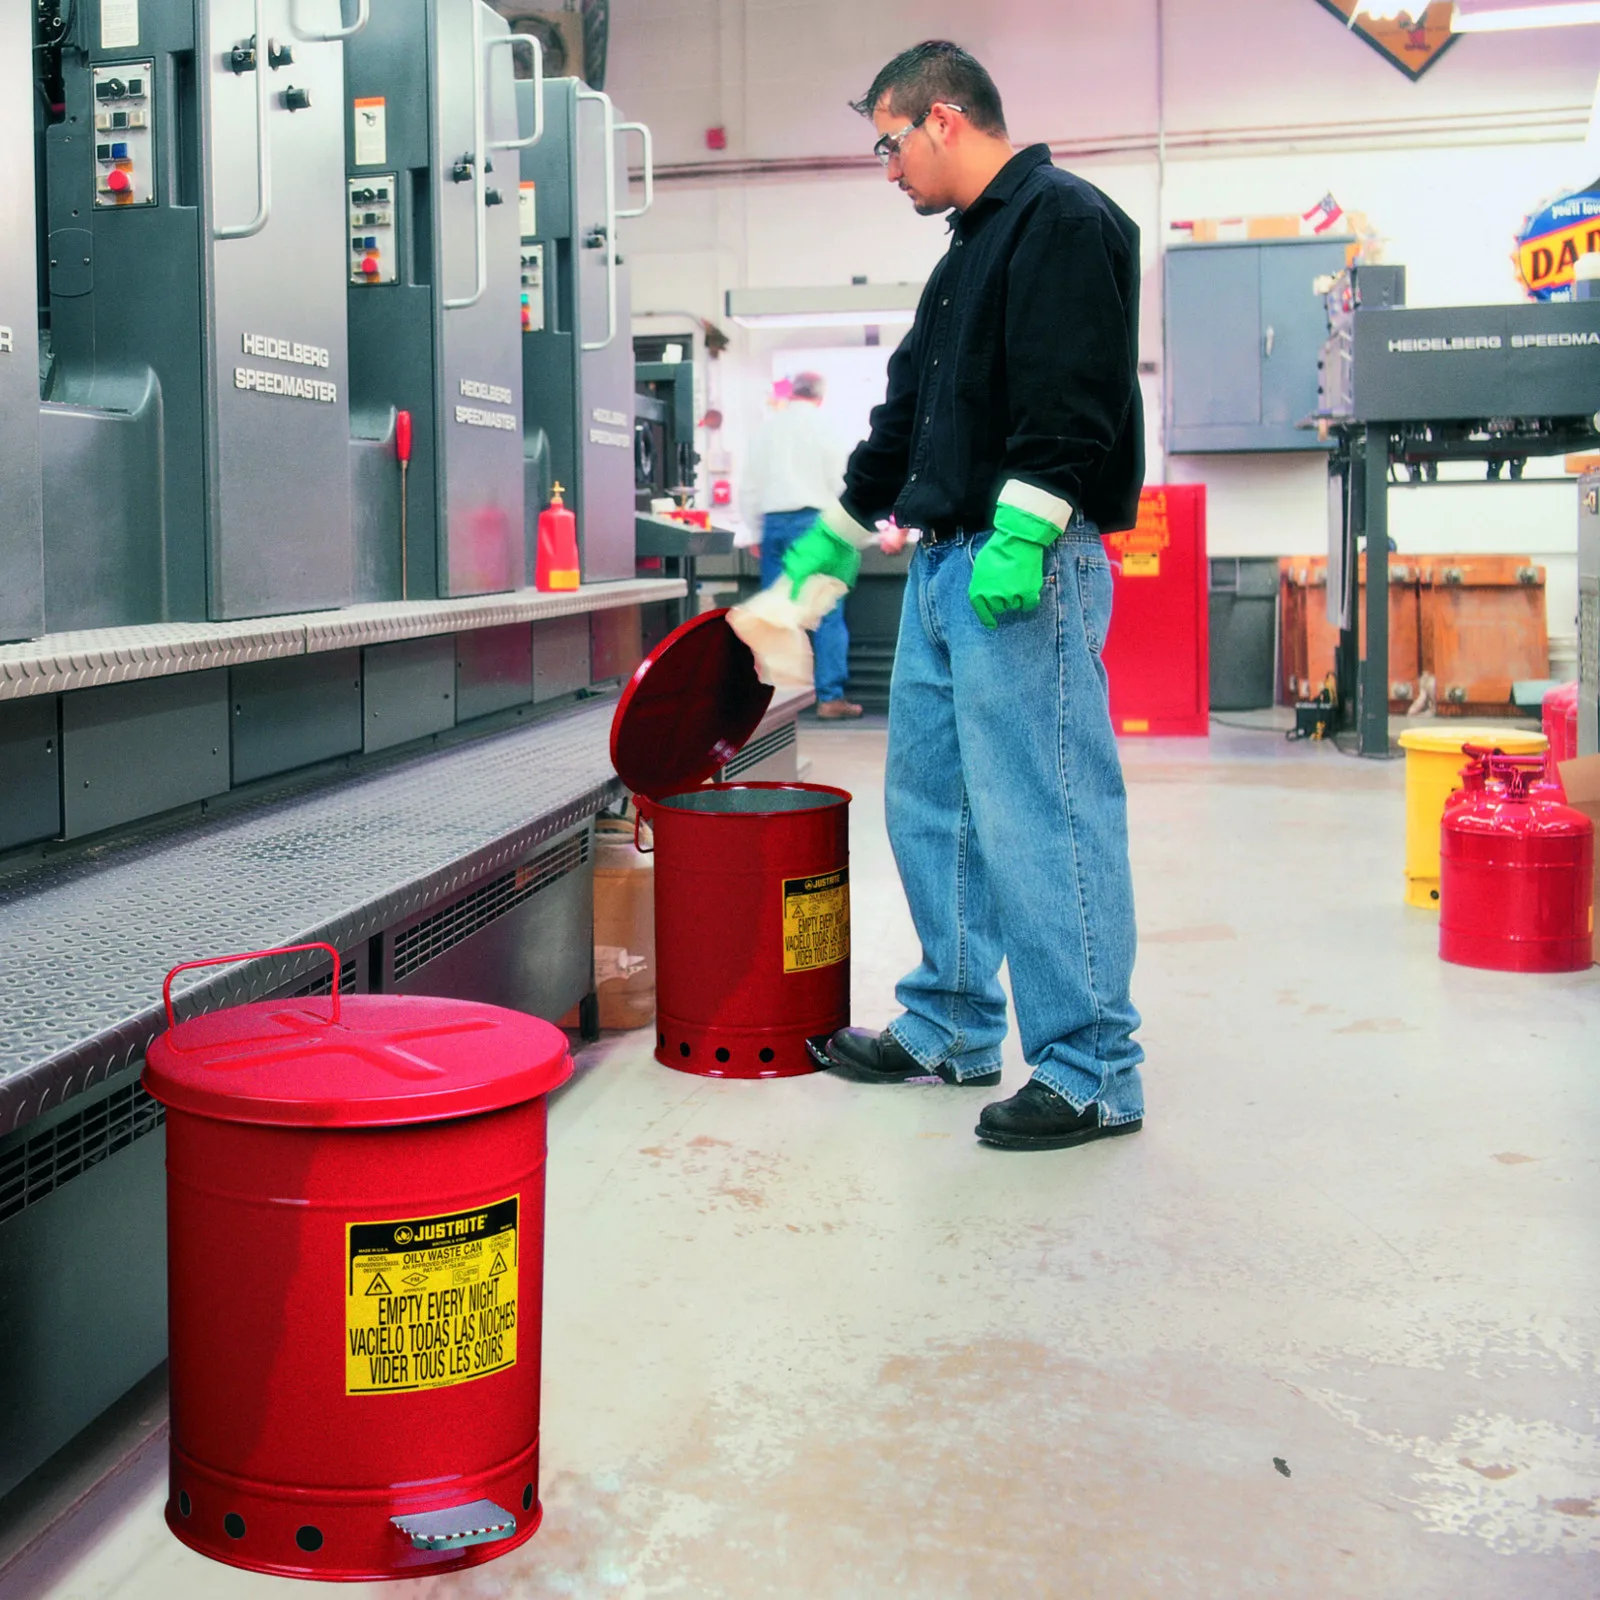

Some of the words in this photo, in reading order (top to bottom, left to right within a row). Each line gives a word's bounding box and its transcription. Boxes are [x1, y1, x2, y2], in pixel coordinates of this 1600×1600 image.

[243, 333, 329, 368] HEIDELBERG
[1388, 335, 1502, 352] HEIDELBERG
[234, 368, 337, 402] SPEEDMASTER
[460, 378, 512, 404] HEIDELBERG
[455, 405, 517, 431] SPEEDMASTER
[798, 917, 818, 934] EMPTY
[414, 1215, 485, 1242] JUSTRITE
[403, 1252, 426, 1264] OILY
[428, 1246, 461, 1261] WASTE
[464, 1241, 482, 1255] CAN
[412, 1261, 440, 1270] APPROVED
[441, 1257, 460, 1265] SAFETY
[461, 1252, 483, 1261] PRODUCT
[379, 1294, 423, 1326] EMPTY
[428, 1286, 466, 1320] EVERY
[468, 1278, 500, 1312] NIGHT
[349, 1326, 404, 1356] VACIELO
[409, 1319, 449, 1352] TODAS
[454, 1314, 475, 1345] LAS
[479, 1300, 516, 1339] NOCHES
[369, 1355, 408, 1384] VIDER
[413, 1350, 445, 1380] TOUS
[449, 1344, 470, 1375] LES
[474, 1334, 503, 1369] SOIRS
